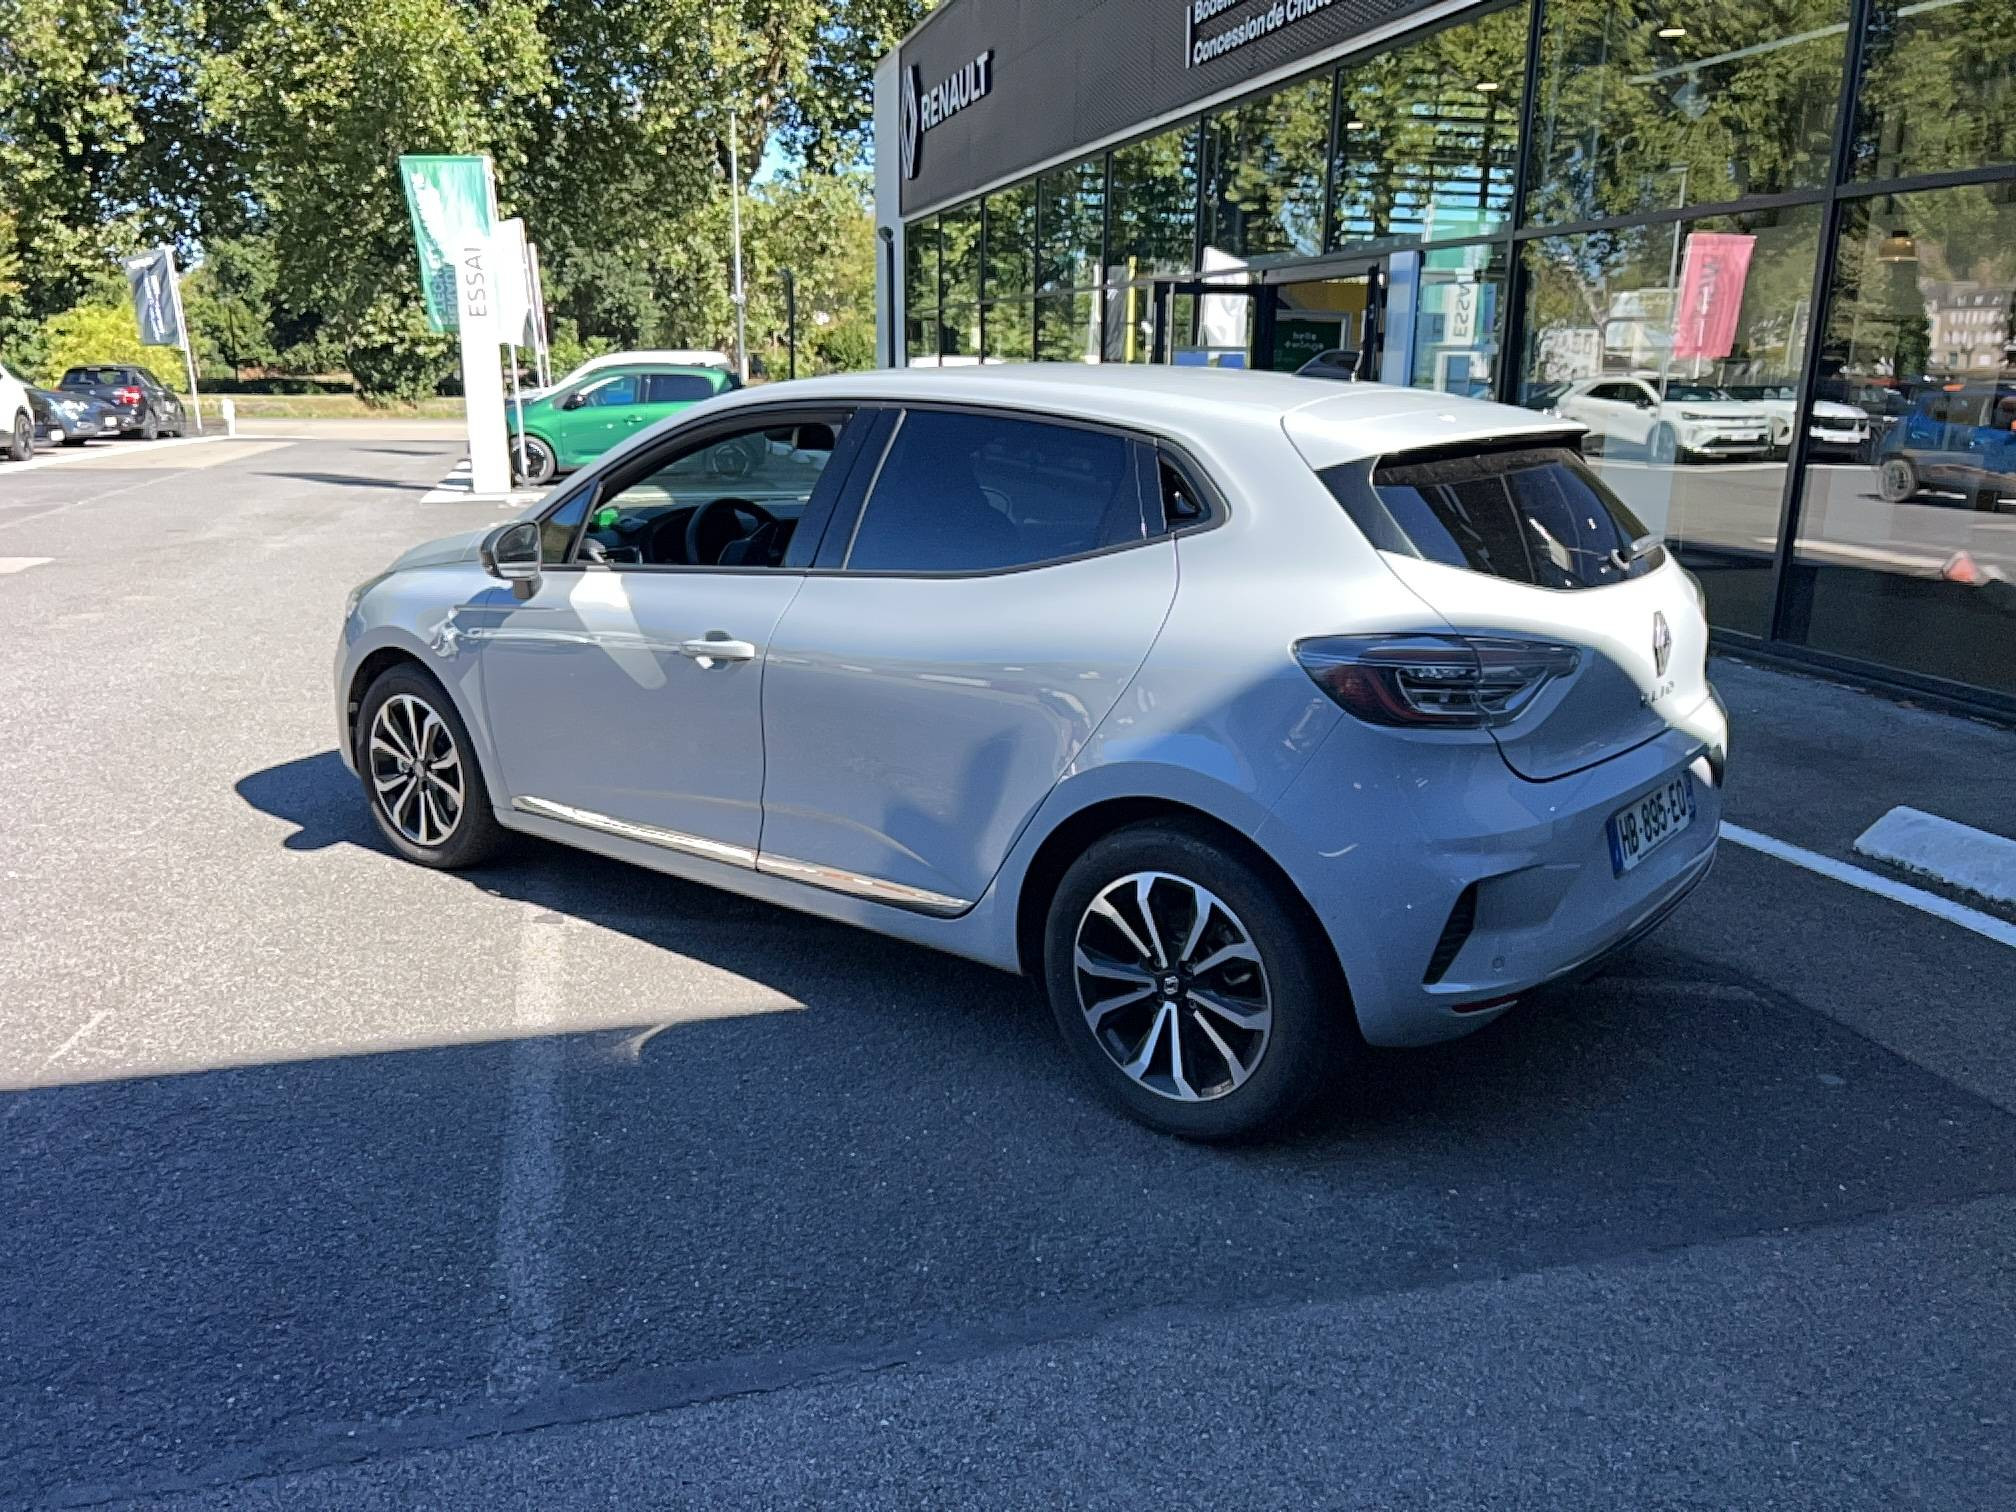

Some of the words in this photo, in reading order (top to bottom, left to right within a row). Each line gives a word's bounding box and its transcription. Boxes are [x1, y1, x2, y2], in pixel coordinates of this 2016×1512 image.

[1193, 16, 1265, 64] Concession
[1267, 2, 1284, 31] de
[921, 51, 988, 132] RENAULT
[464, 248, 487, 316] ESSAI
